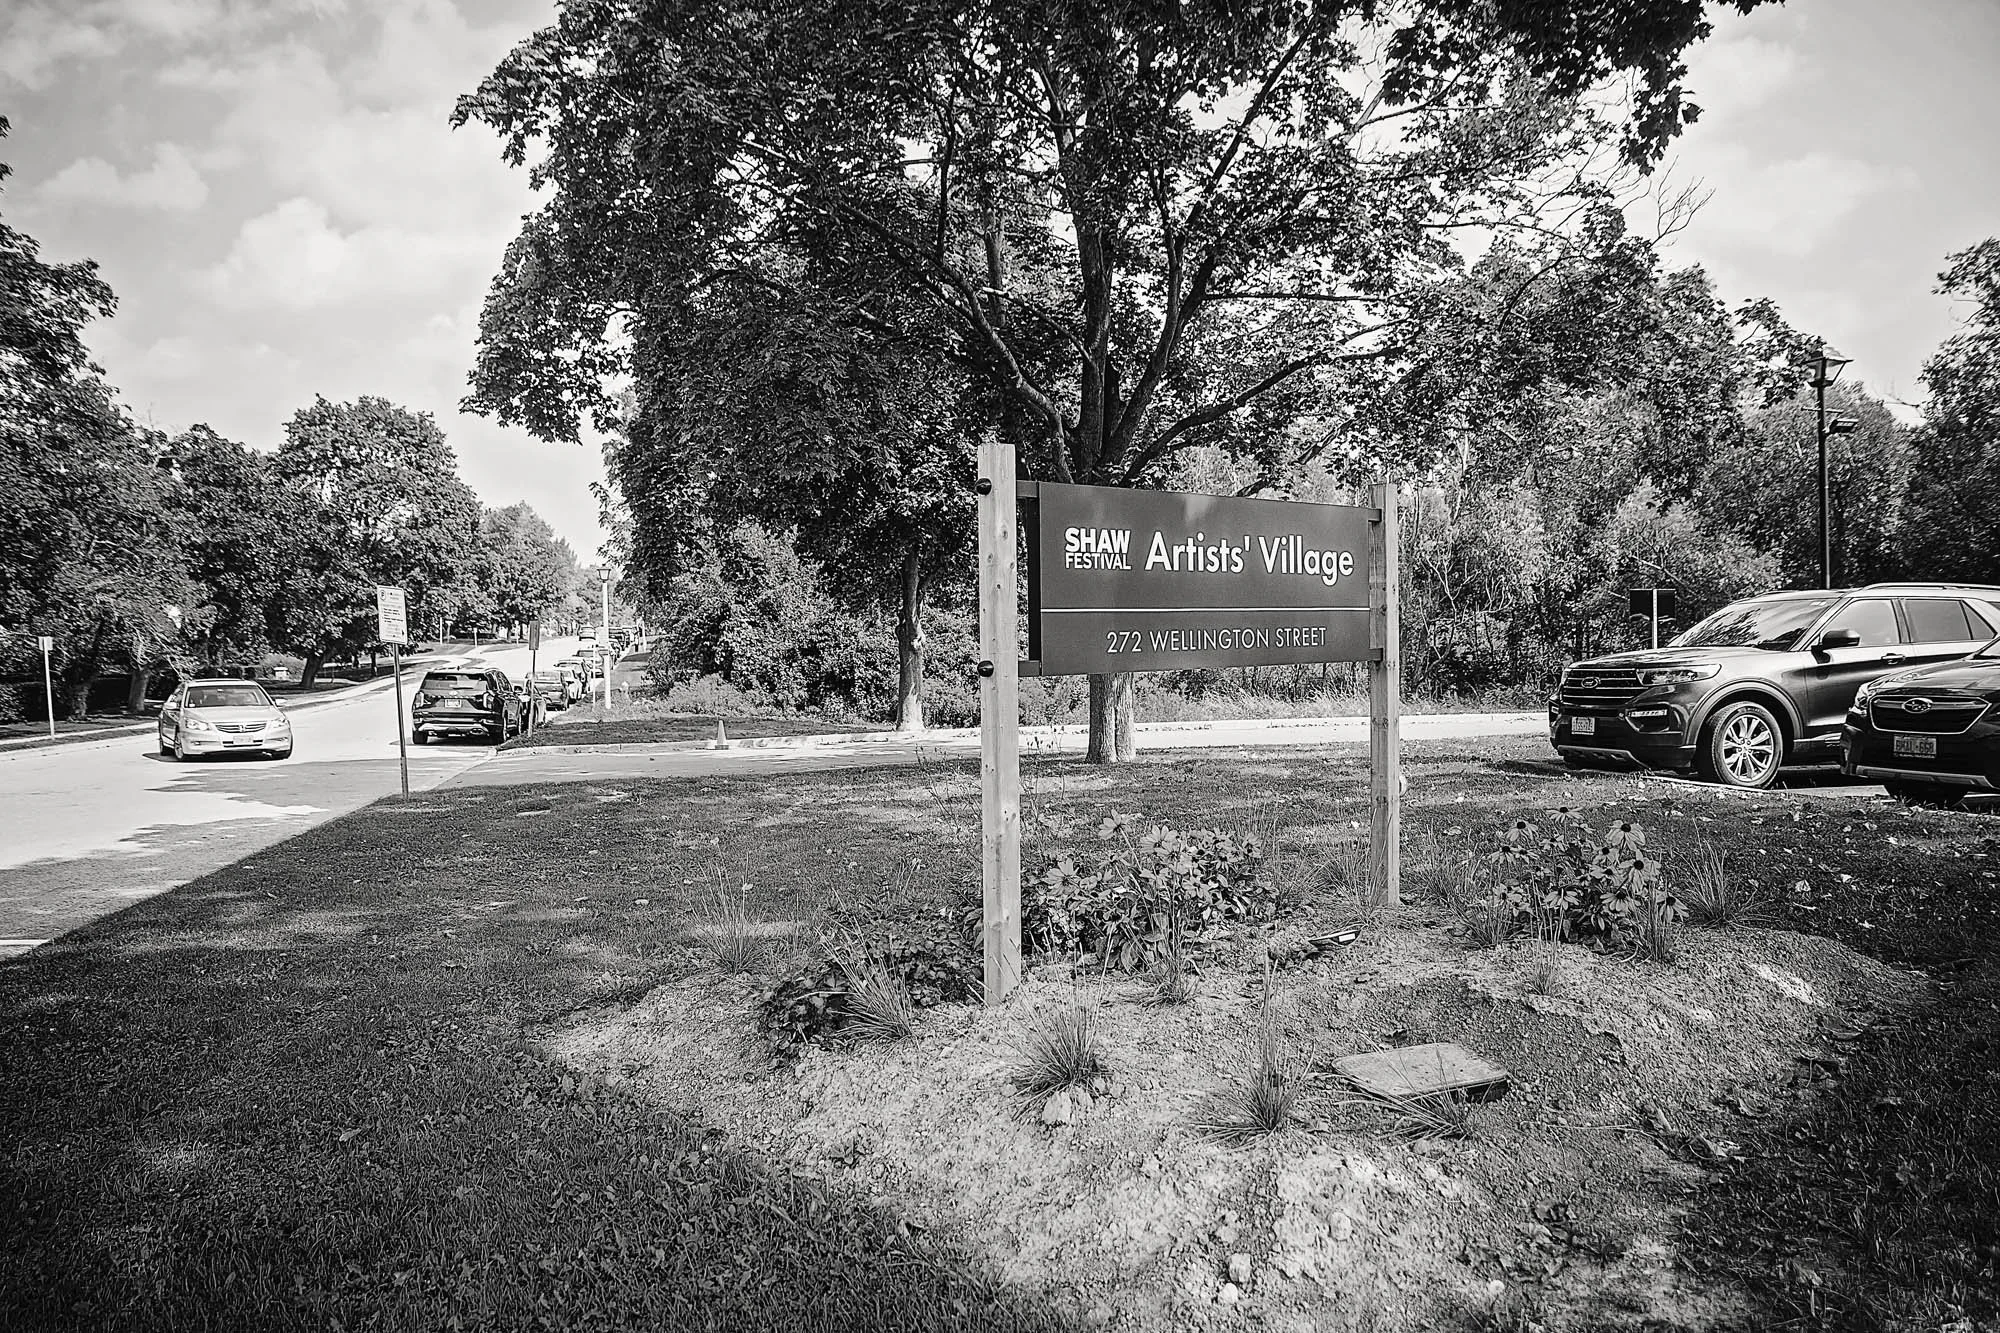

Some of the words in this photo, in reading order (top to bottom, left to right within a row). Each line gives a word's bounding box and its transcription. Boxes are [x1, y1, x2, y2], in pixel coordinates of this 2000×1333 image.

[1065, 527, 1131, 554] SHAW
[1065, 553, 1132, 570] FESTIVAL
[1144, 531, 1251, 573] Artists'
[1258, 534, 1354, 586] Village
[1106, 631, 1142, 653] 272
[1149, 628, 1269, 652] WELLINGTON
[1275, 627, 1326, 648] STREET
